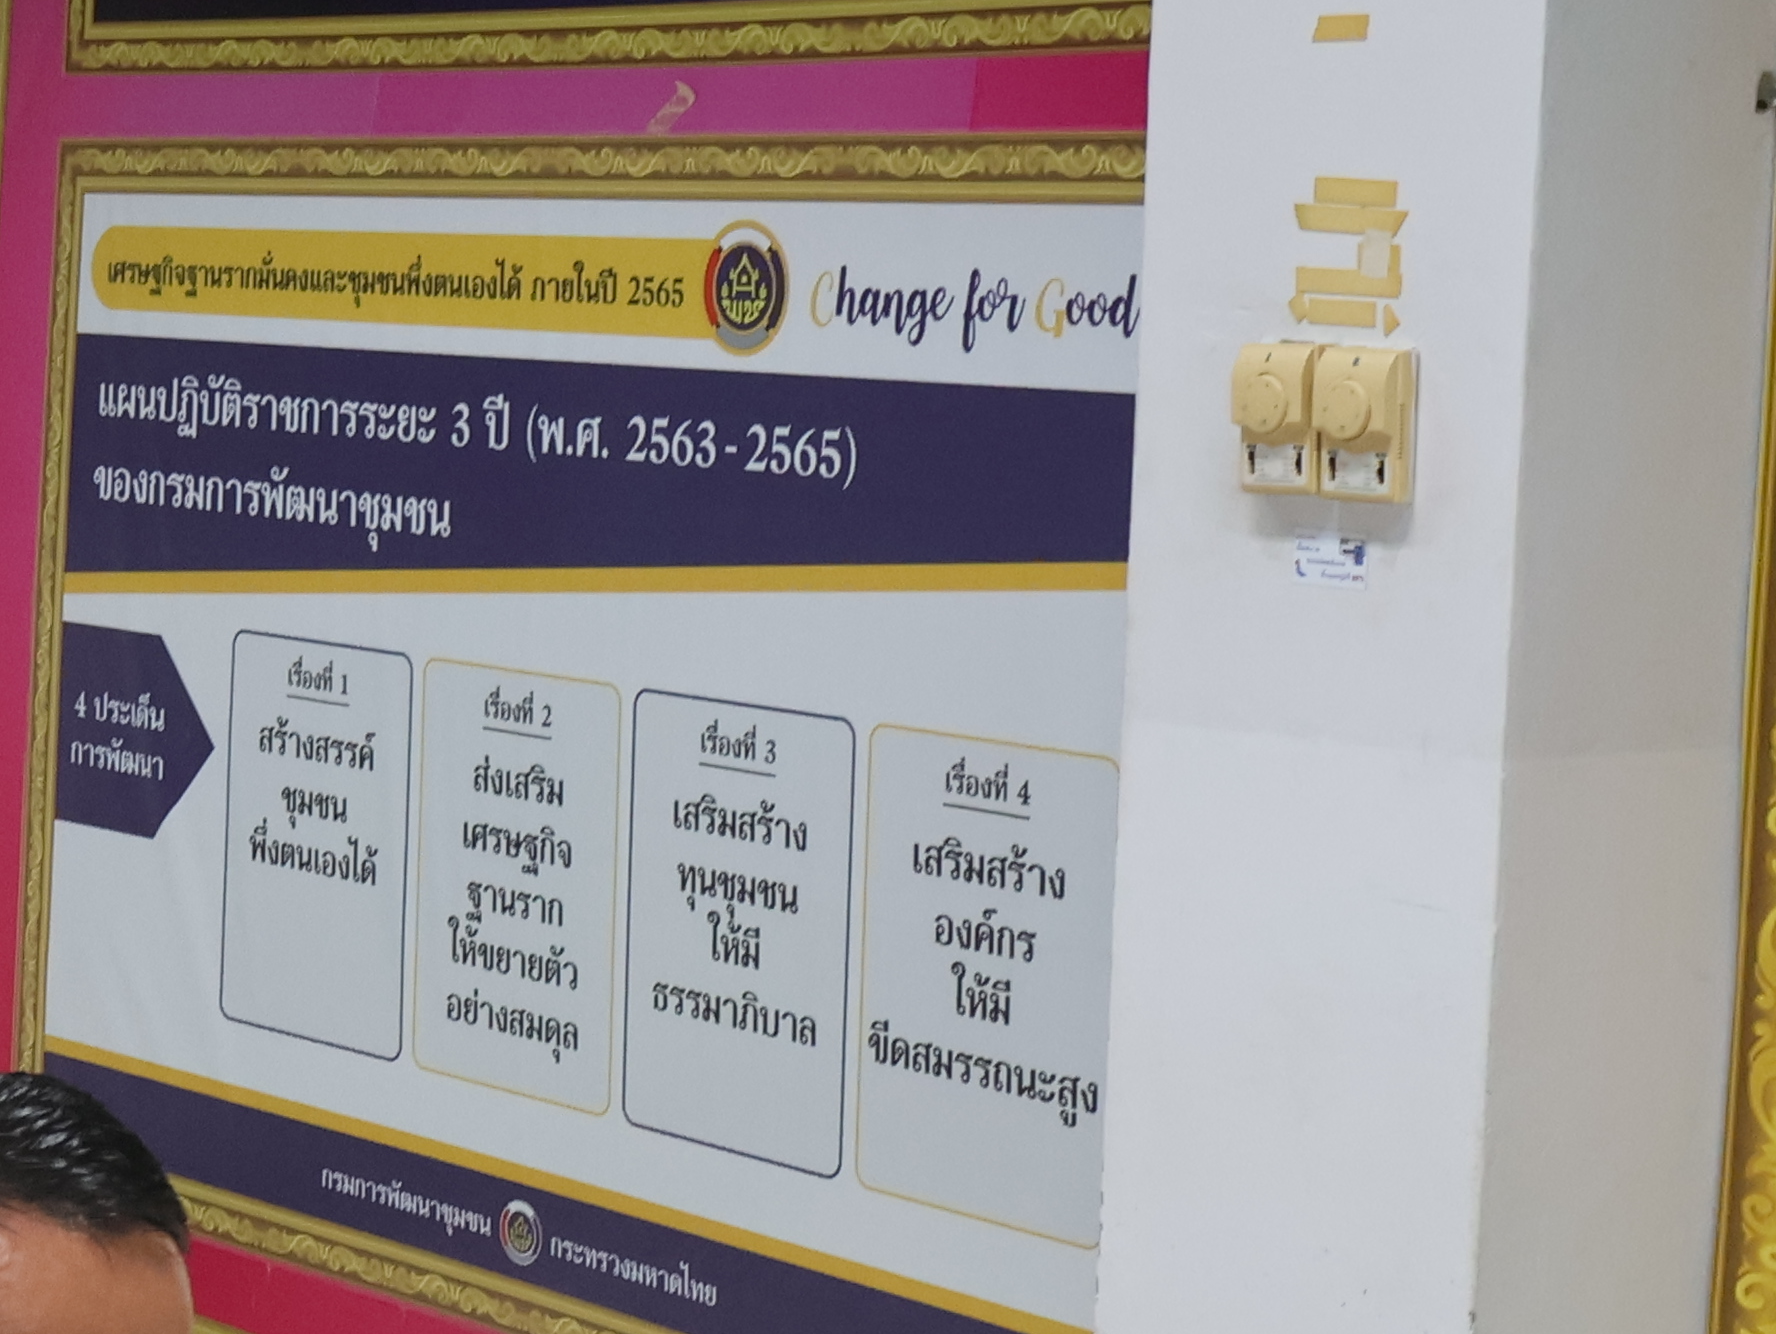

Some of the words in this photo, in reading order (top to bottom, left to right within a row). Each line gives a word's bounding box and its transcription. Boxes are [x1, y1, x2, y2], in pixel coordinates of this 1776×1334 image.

[107, 250, 521, 310] เศรษฐกิจฐานรากมั่นคงและชุมชนพึ่งตนเองได้
[530, 260, 619, 306] ภายในปี
[626, 275, 685, 308] 2565
[809, 265, 954, 347] Change
[960, 267, 1028, 353] for
[1035, 273, 1141, 340] Good
[97, 372, 438, 446] แผนปฏิบัติราชการระยะ
[451, 400, 472, 448] 3
[485, 391, 510, 451] ปี
[525, 403, 610, 465] (พ.ศ.
[93, 464, 453, 552] ของกรมการพัฒนาชุมชน
[286, 655, 335, 695] เรื่องที่
[339, 671, 349, 697] 1
[73, 692, 89, 719] 4
[93, 686, 167, 735] ประเด็น
[483, 688, 536, 727] เรื่องที่
[540, 703, 553, 729] 2
[70, 736, 166, 782] การพัฒนา
[258, 718, 377, 773] สร้างสรรค์
[699, 719, 757, 763] เรื่องที่
[764, 736, 777, 765] 3
[280, 782, 348, 831] ชุมชน
[472, 756, 565, 809] ส่งเสริม
[944, 758, 1010, 805] เรื่องที่
[1016, 777, 1032, 807] 4
[461, 817, 573, 878] เศรษฐกิจ
[672, 796, 810, 854] เสริมสร้าง
[248, 827, 379, 888] พึ่งตนเองได้
[912, 838, 1067, 901] เสริมสร้าง
[466, 877, 565, 930] ฐานราก
[676, 858, 800, 919] ทุนชุมชน
[447, 915, 581, 993] ให้ขยายตัว
[706, 910, 762, 971] ให้มี
[933, 908, 1037, 965] องค์กร
[650, 978, 818, 1049] ธรรมาภิบาล
[950, 963, 1014, 1027] ให้มี
[445, 988, 580, 1065] อย่างสมดุล
[867, 1021, 1100, 1128] ขีดสมรรถนะสูง
[320, 1163, 493, 1241] กรมการพัฒนาชุมชน
[549, 1228, 719, 1310] กระทรวงมหาดไทย
